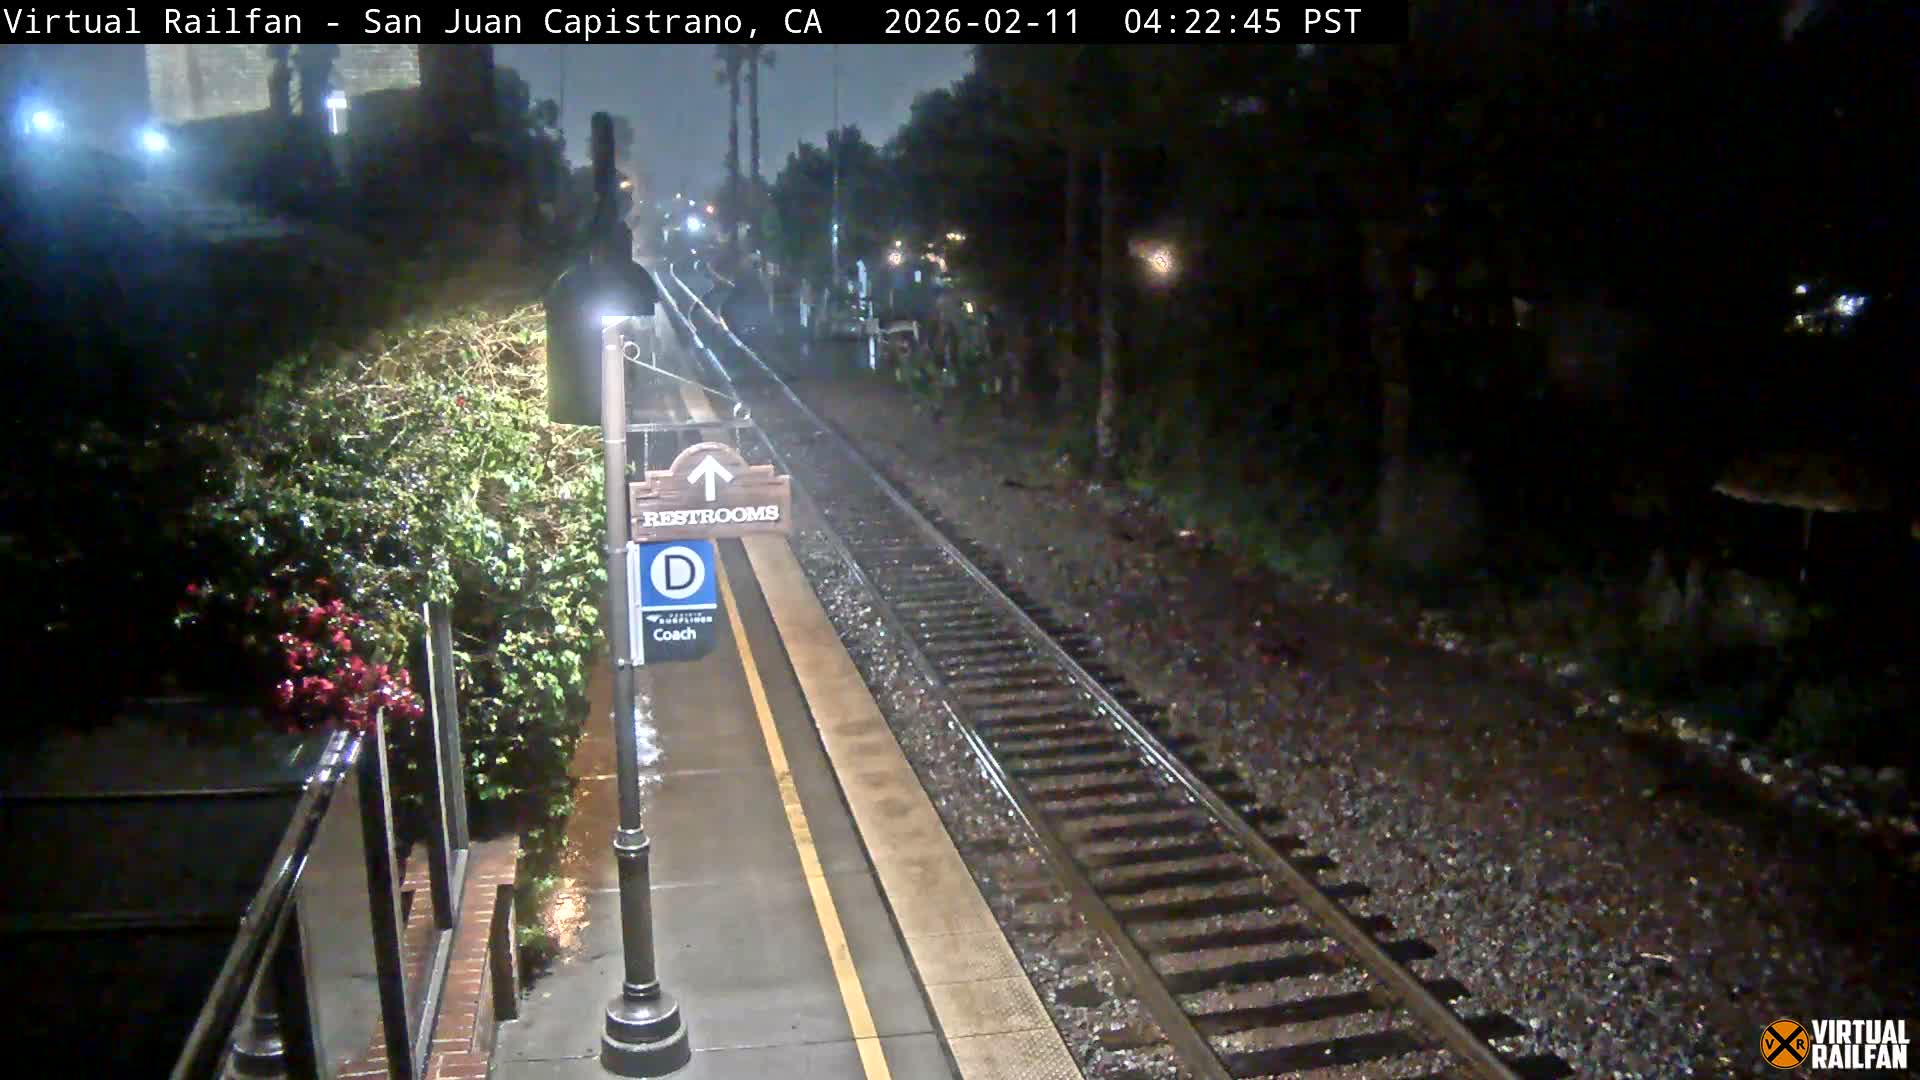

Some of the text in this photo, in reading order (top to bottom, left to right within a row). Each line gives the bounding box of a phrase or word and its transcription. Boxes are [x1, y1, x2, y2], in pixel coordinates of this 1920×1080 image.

[643, 506, 779, 527] RESTROOMS
[664, 555, 695, 590] D
[654, 627, 696, 642] Coach
